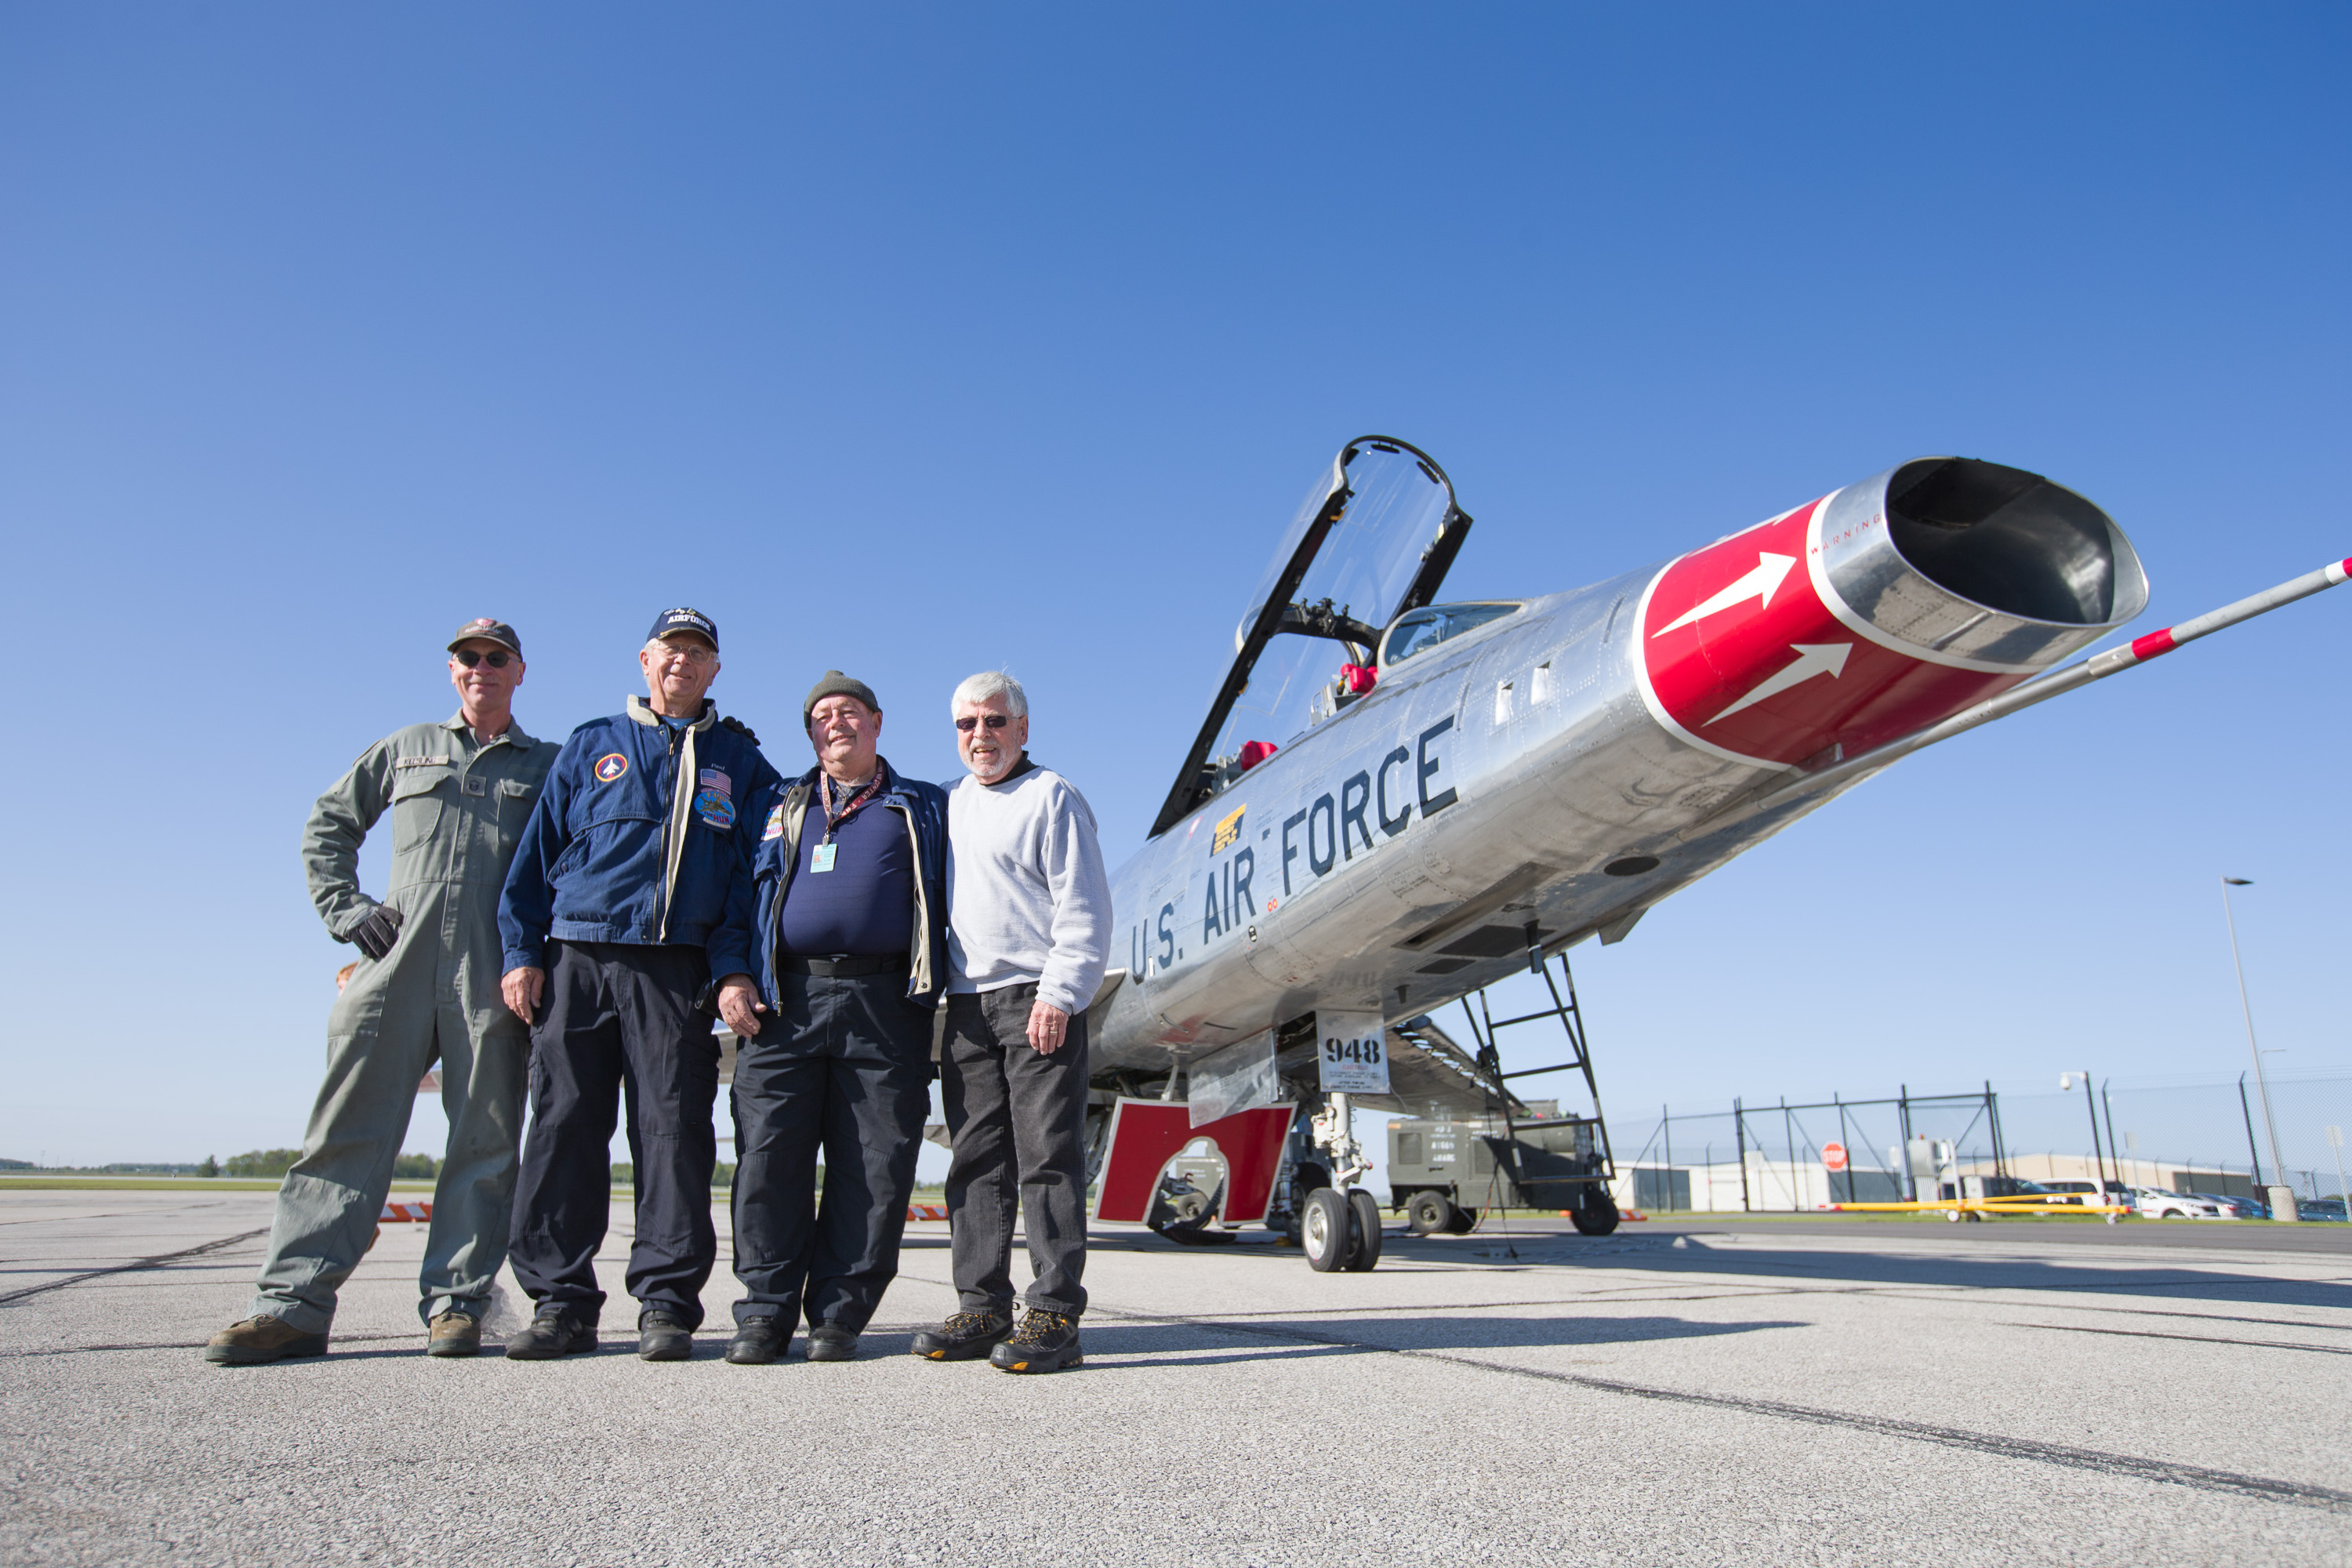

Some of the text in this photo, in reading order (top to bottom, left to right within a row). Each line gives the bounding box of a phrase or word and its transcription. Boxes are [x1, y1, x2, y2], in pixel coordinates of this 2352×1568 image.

[1809, 514, 1881, 555] WARNING
[861, 779, 880, 800] CENTER
[1132, 714, 1458, 985] U.S. AIR FORCE
[1326, 1037, 1381, 1065] 948
[1823, 1150, 1845, 1163] STOP
